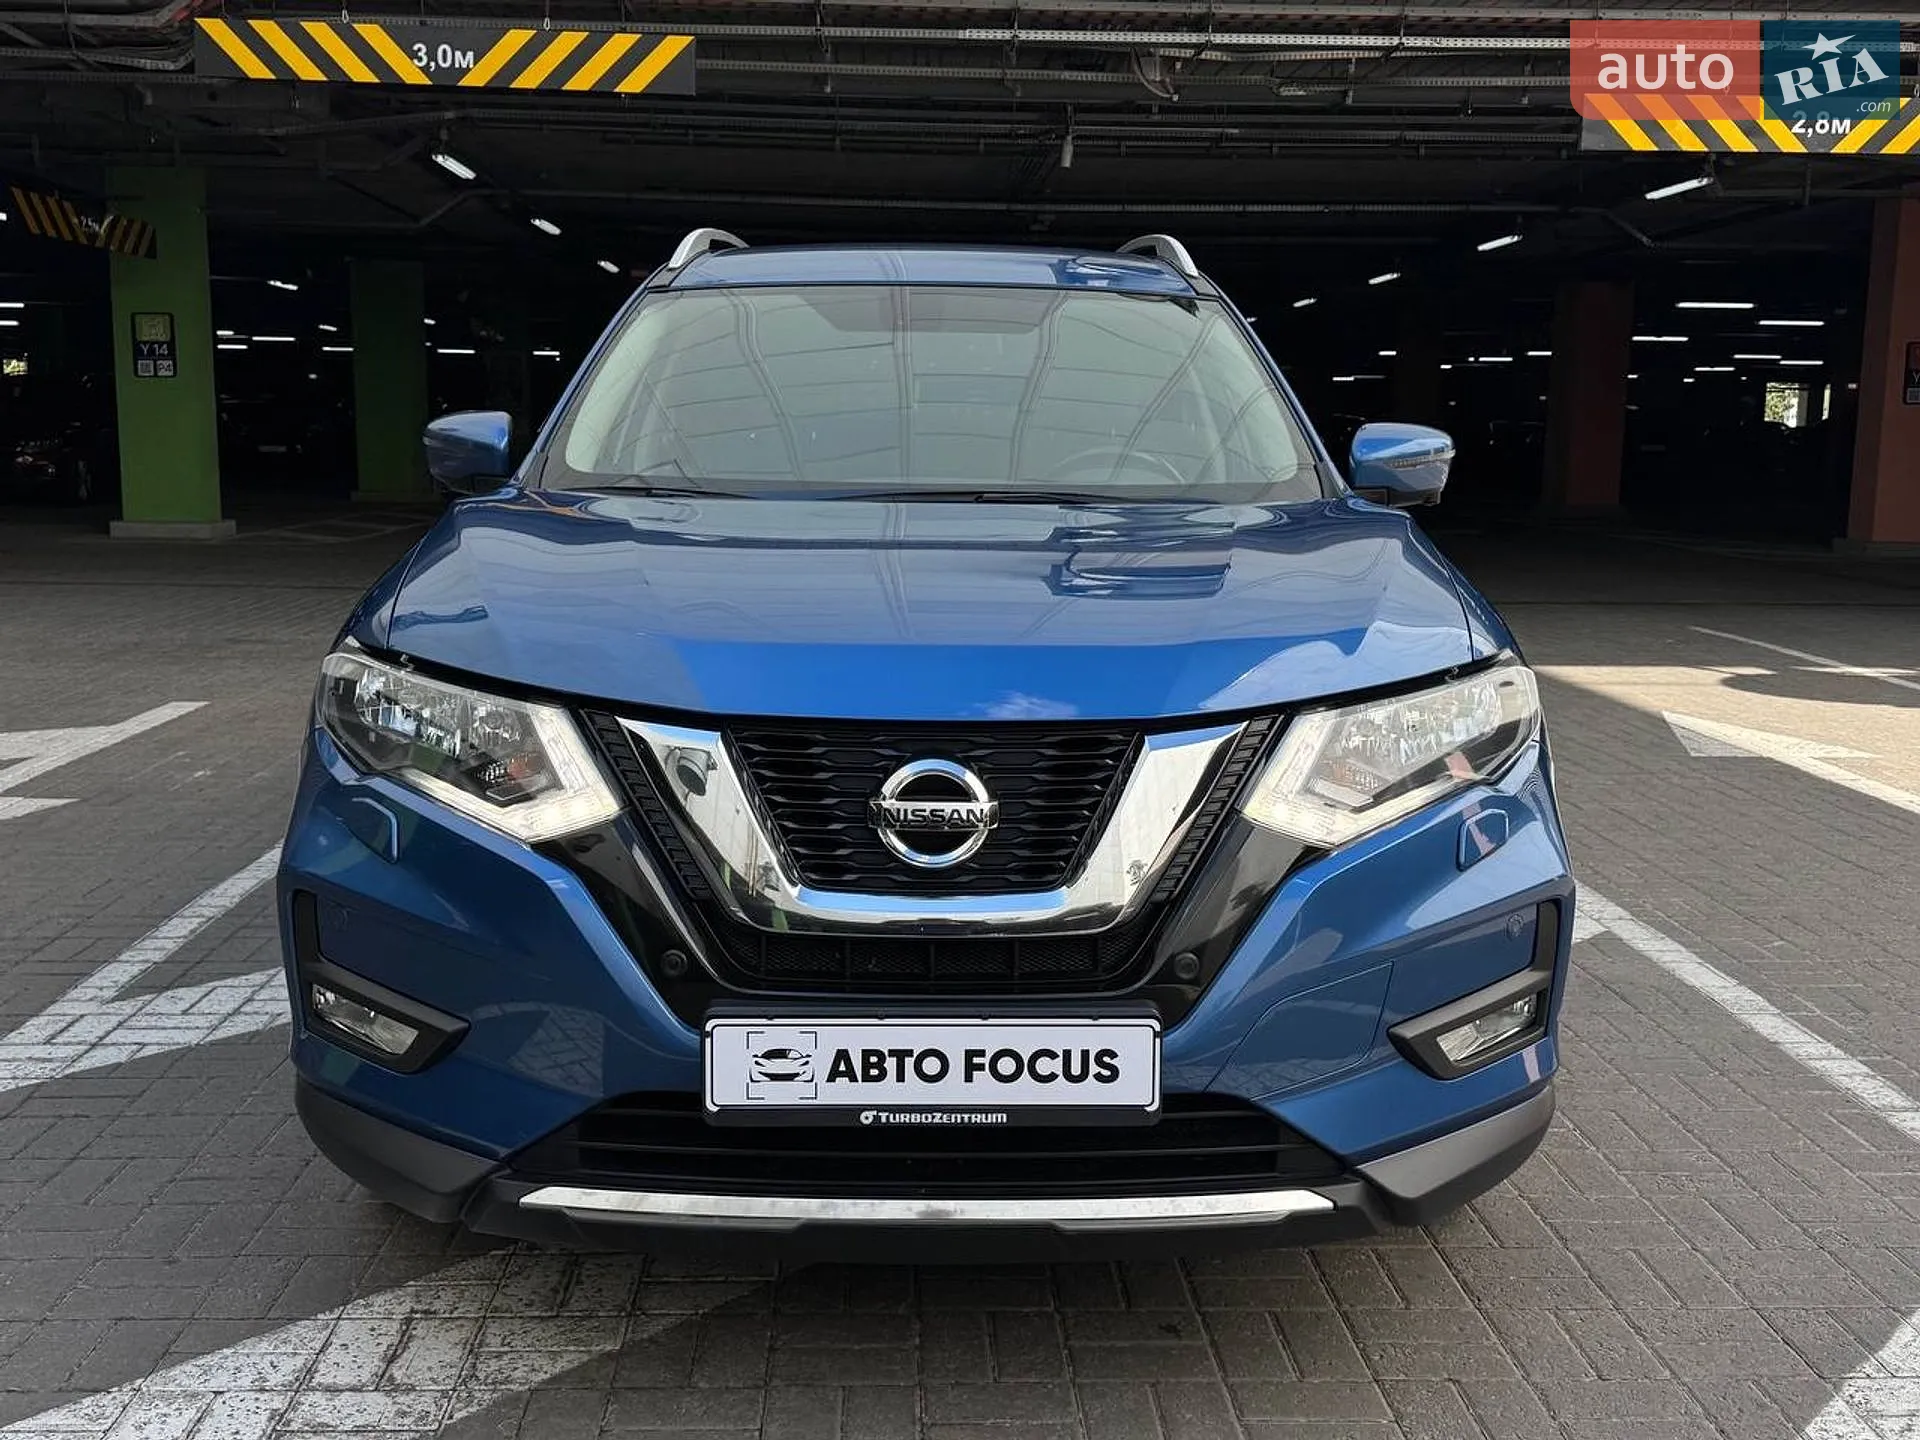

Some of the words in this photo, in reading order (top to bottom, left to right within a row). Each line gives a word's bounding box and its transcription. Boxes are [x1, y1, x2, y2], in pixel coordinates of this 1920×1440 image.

[412, 43, 474, 72] 3,0м
[1791, 110, 1850, 138] 2,8м
[153, 343, 168, 356] 14
[883, 808, 984, 825] NISSAN
[825, 1048, 951, 1084] АВТО
[964, 1047, 1121, 1084] FOCUS
